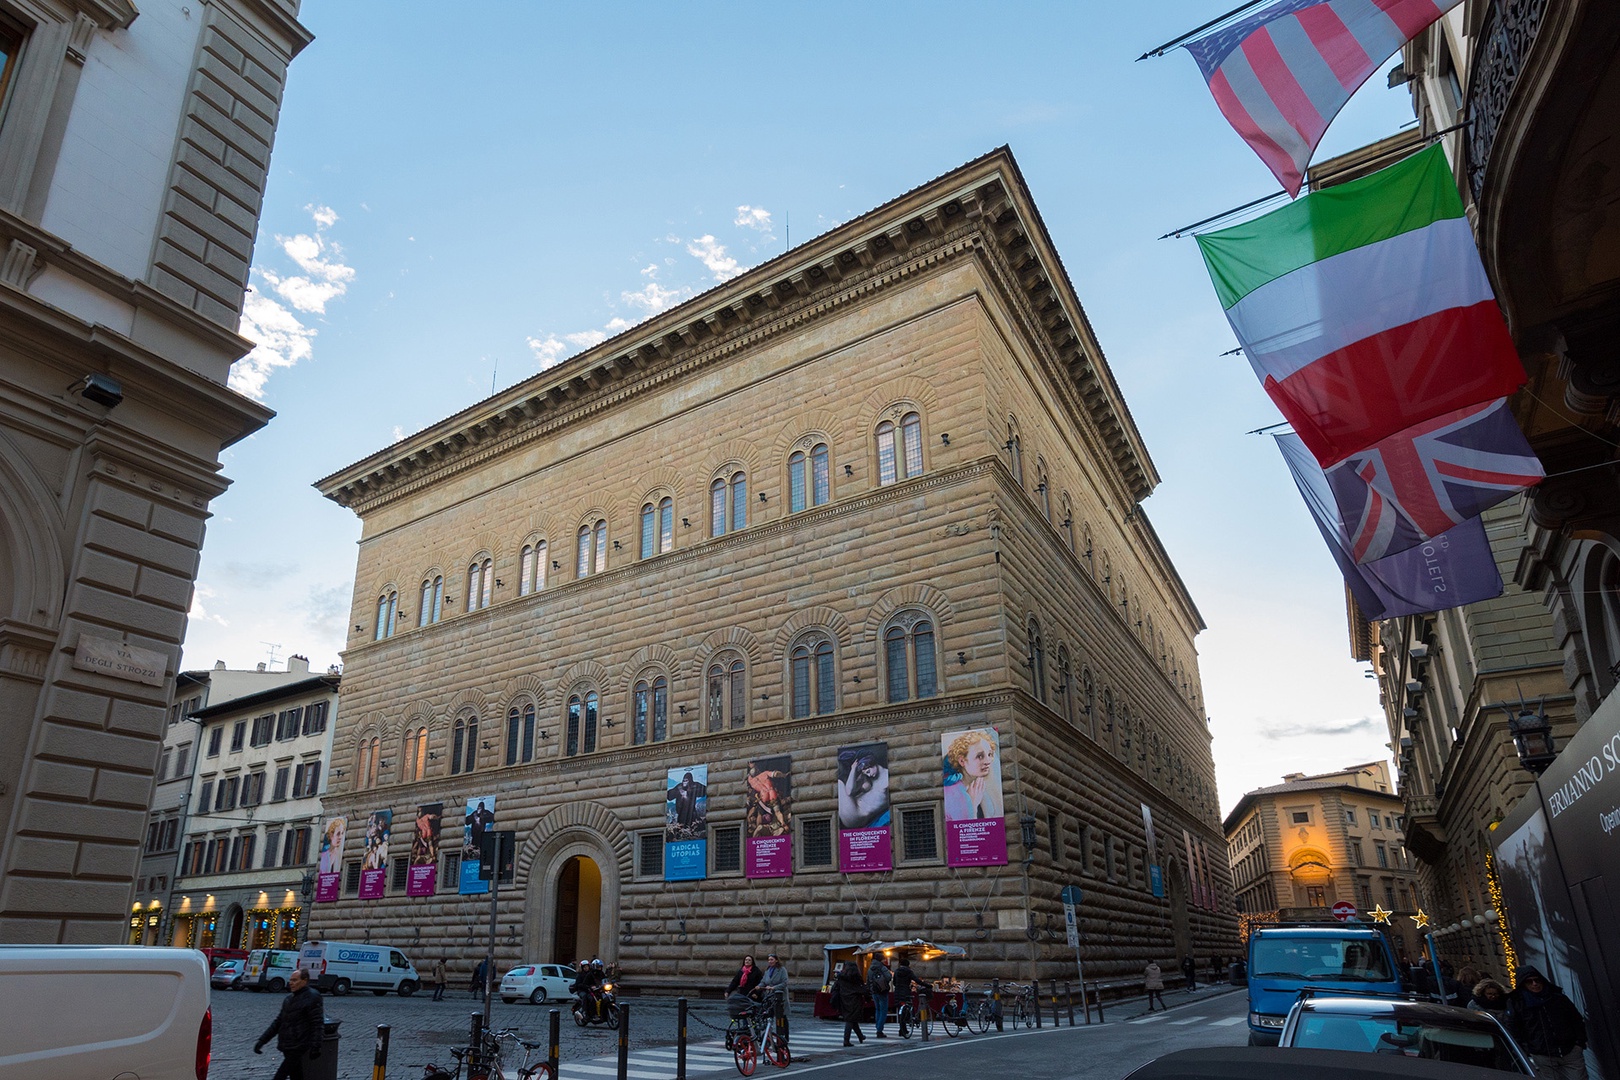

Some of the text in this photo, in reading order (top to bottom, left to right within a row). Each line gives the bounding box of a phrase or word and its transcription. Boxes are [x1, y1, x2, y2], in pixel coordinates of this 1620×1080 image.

[117, 649, 132, 659] VIA
[85, 656, 157, 678] DEGLI STROZZI
[1548, 755, 1603, 818] ERMANNO
[959, 821, 997, 829] CINQUECENTO
[671, 843, 700, 851] RADICAL
[671, 850, 701, 858] UTOPIAS
